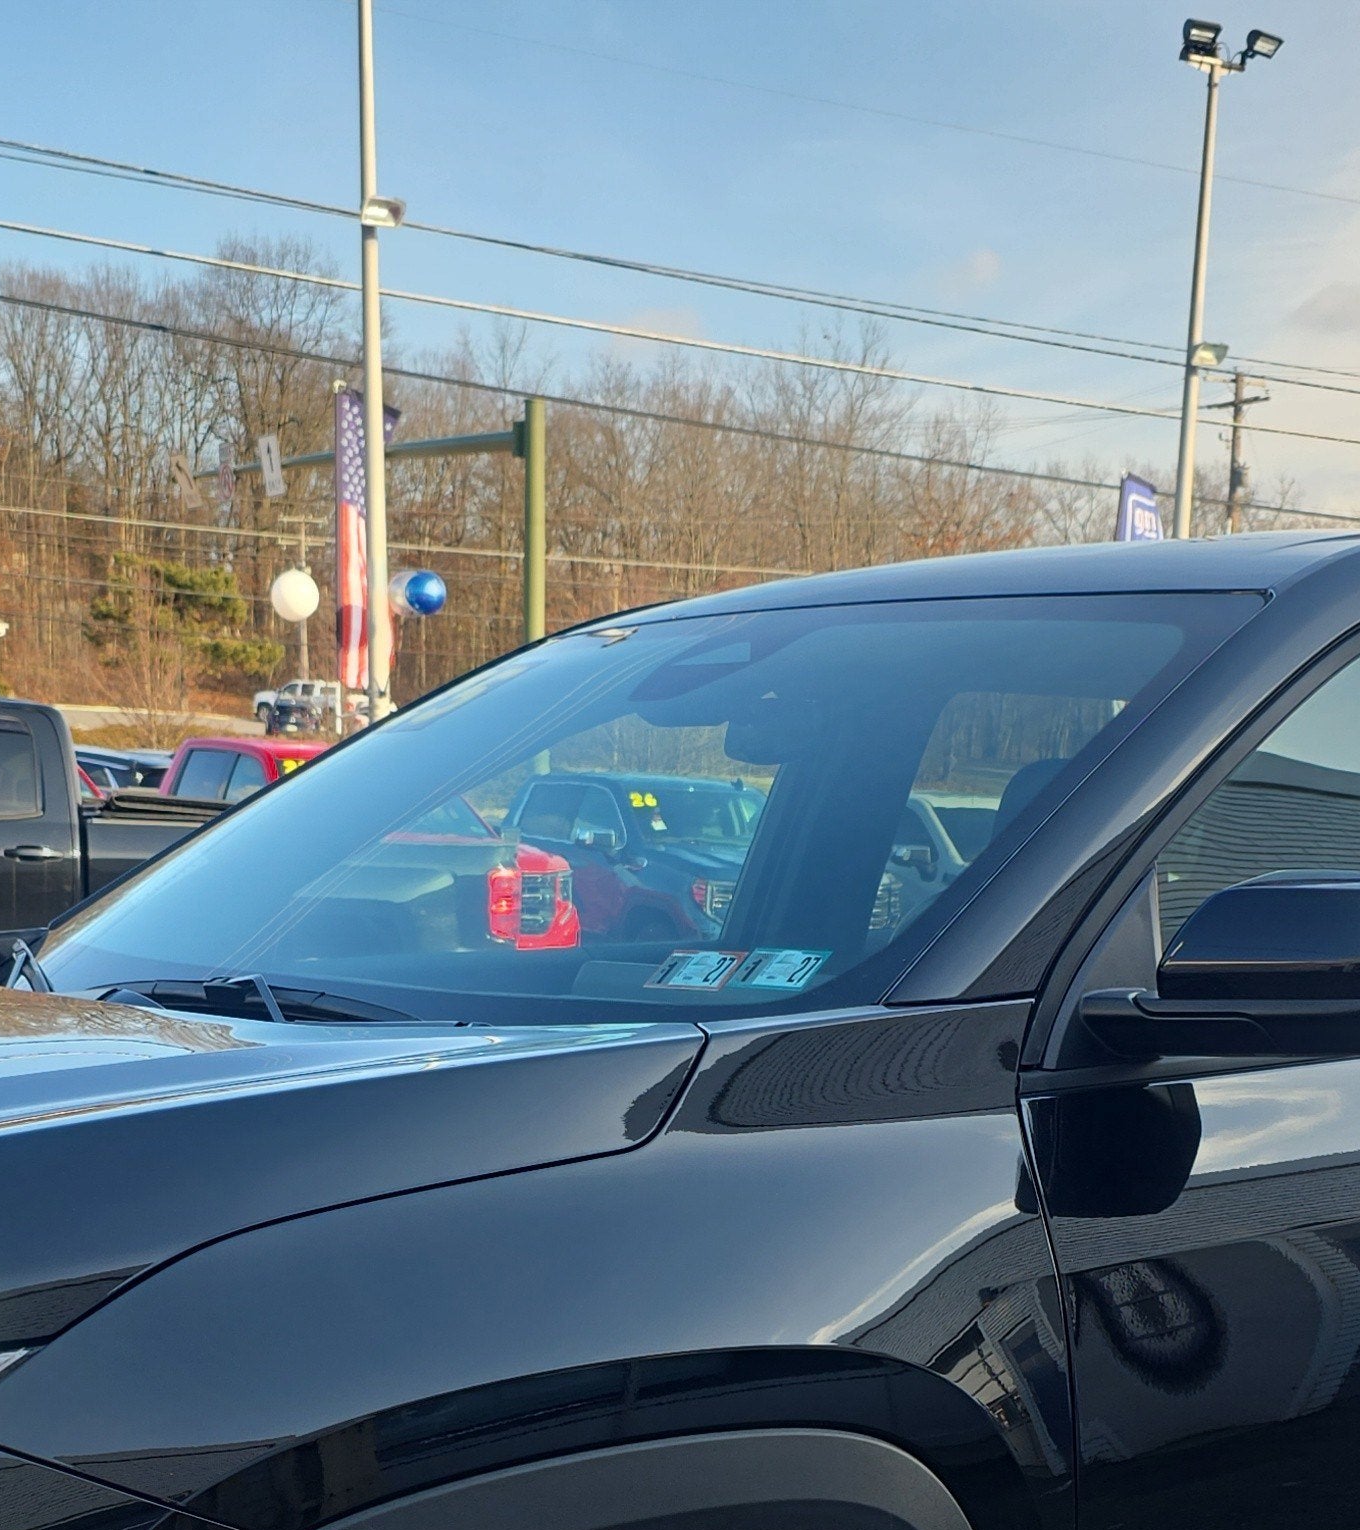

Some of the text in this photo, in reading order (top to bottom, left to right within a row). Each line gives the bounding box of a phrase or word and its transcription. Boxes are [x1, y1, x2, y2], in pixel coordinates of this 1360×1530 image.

[630, 792, 657, 808] 26
[702, 957, 736, 985] 27
[786, 956, 822, 984] 27
